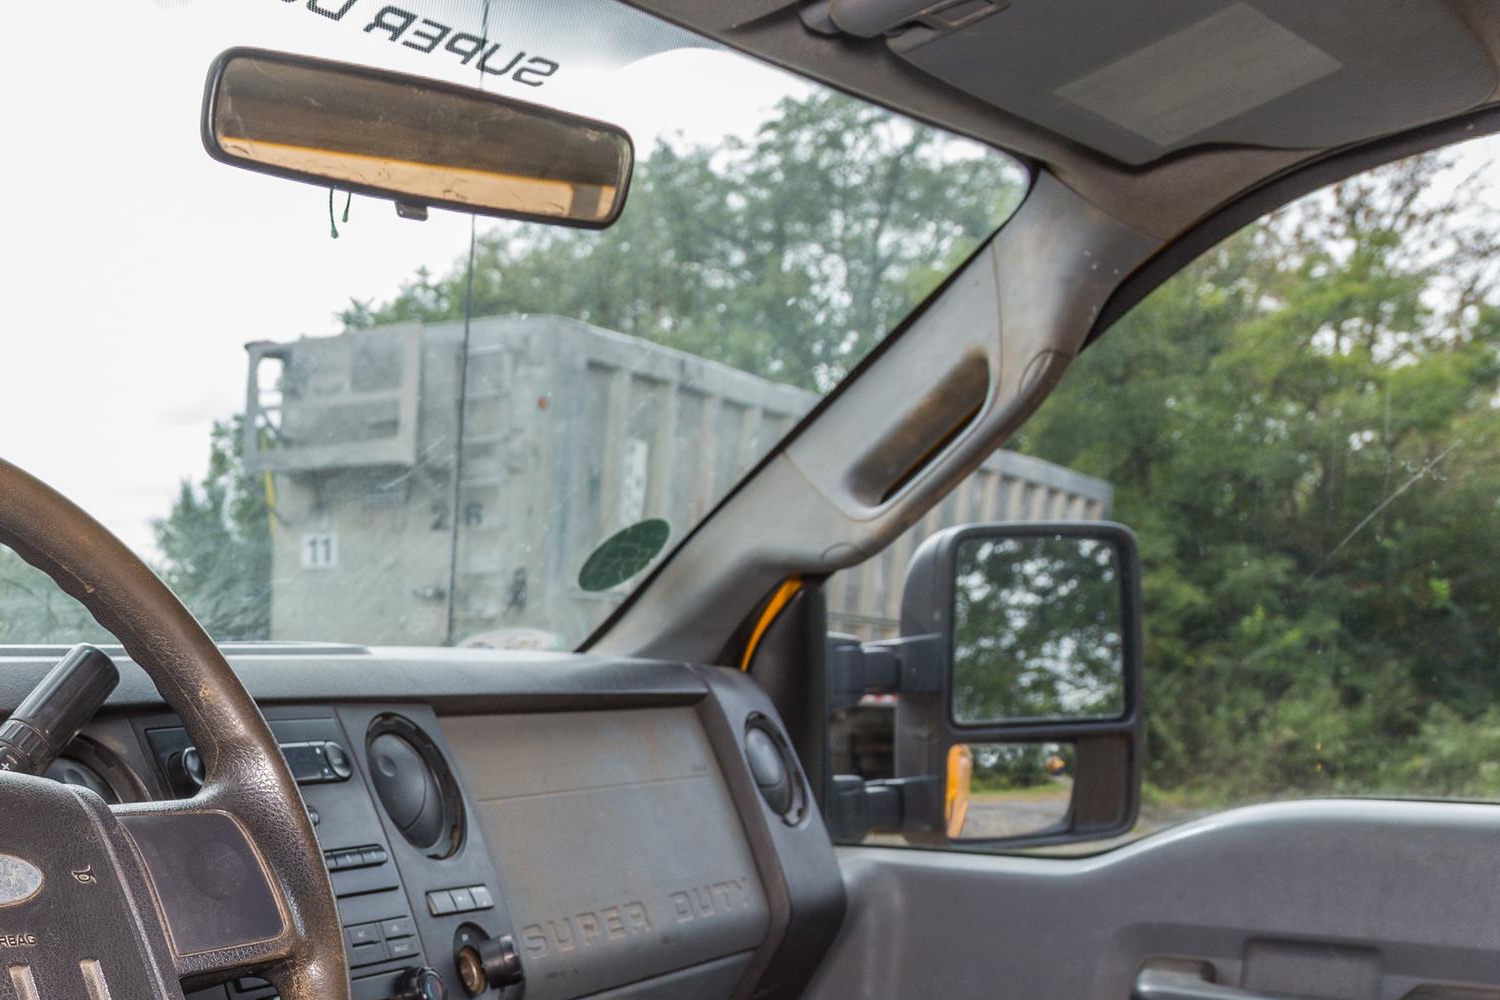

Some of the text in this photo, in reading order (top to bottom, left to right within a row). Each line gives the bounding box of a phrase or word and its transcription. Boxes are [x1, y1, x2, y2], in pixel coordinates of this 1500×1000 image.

[308, 537, 331, 563] 11
[522, 877, 751, 960] SUPER DUTY
